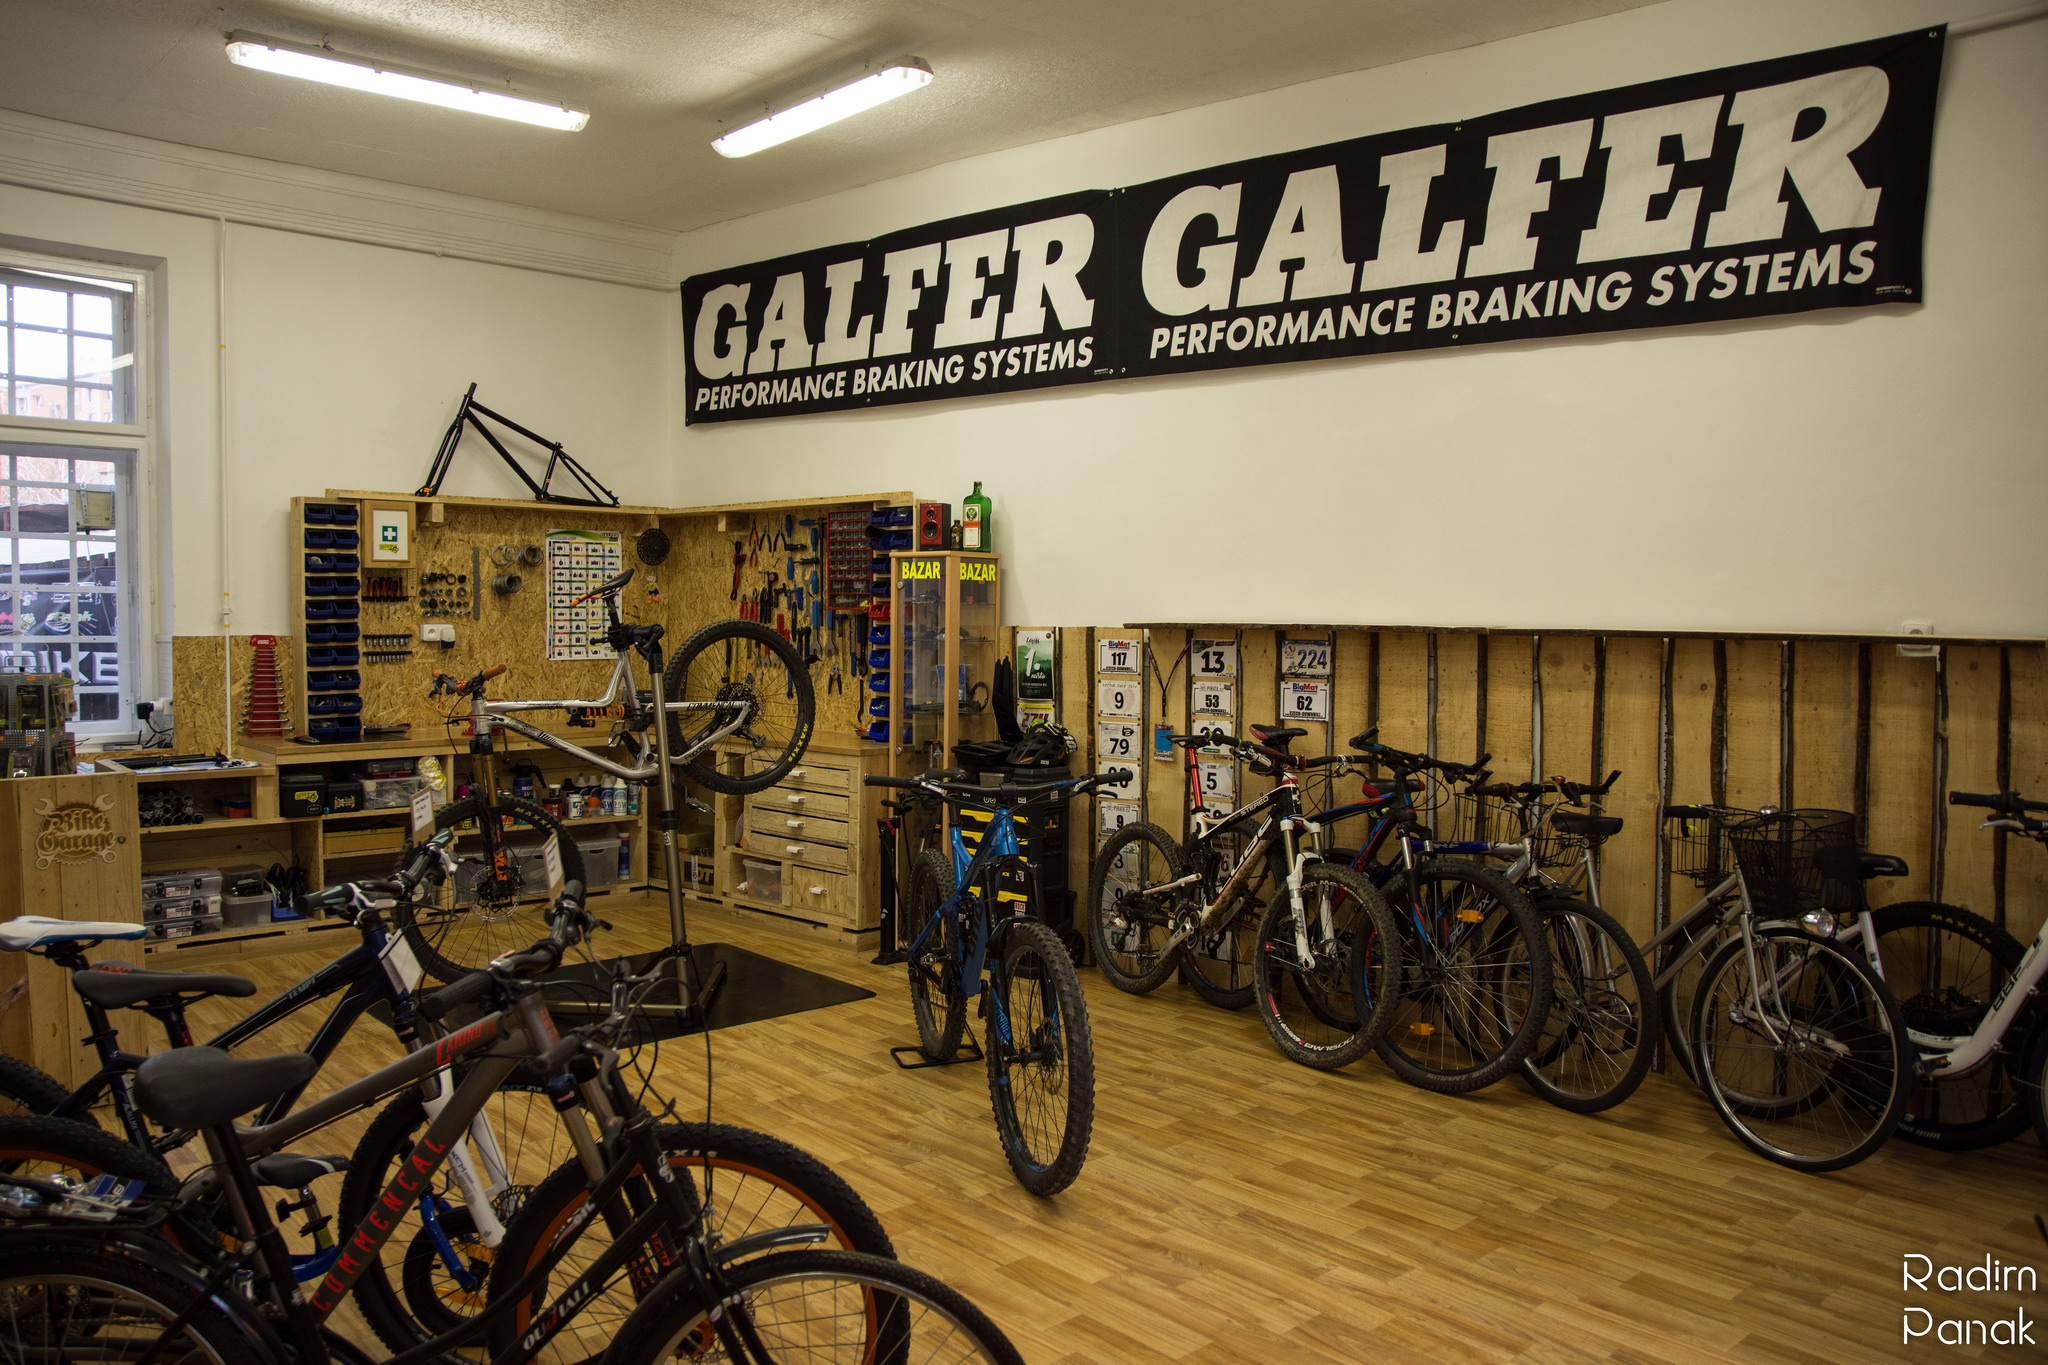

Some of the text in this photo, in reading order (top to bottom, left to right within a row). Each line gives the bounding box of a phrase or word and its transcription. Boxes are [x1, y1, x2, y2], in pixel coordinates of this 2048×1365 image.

[1141, 65, 1890, 317] GALFER
[693, 213, 1095, 380] GALFER
[1150, 240, 1877, 360] PERFORMANCE BRAKING SYSTEMS
[694, 336, 1095, 411] PERFORMANCE BRAKING SYSTEMS
[902, 562, 941, 580] BAZAR
[960, 562, 997, 582] BAZAR
[1109, 640, 1130, 649] BigMat
[1112, 652, 1127, 666] 117
[1201, 651, 1225, 673] 13
[1297, 649, 1327, 669] 224
[1292, 683, 1318, 692] BigMat
[1115, 692, 1124, 709] 9
[1205, 694, 1219, 708] 53
[1296, 696, 1313, 711] 62
[788, 723, 809, 762] MAXXIS
[1110, 738, 1129, 755] 79
[1240, 795, 1269, 817] STEREO
[48, 809, 104, 832] Bike
[1116, 814, 1124, 828] 9
[38, 831, 114, 854] Garage
[494, 850, 507, 881] FOX
[1931, 914, 1993, 945] MAXXIS
[437, 1023, 482, 1066] CAMINO
[312, 1138, 446, 1311] COMMENCAL
